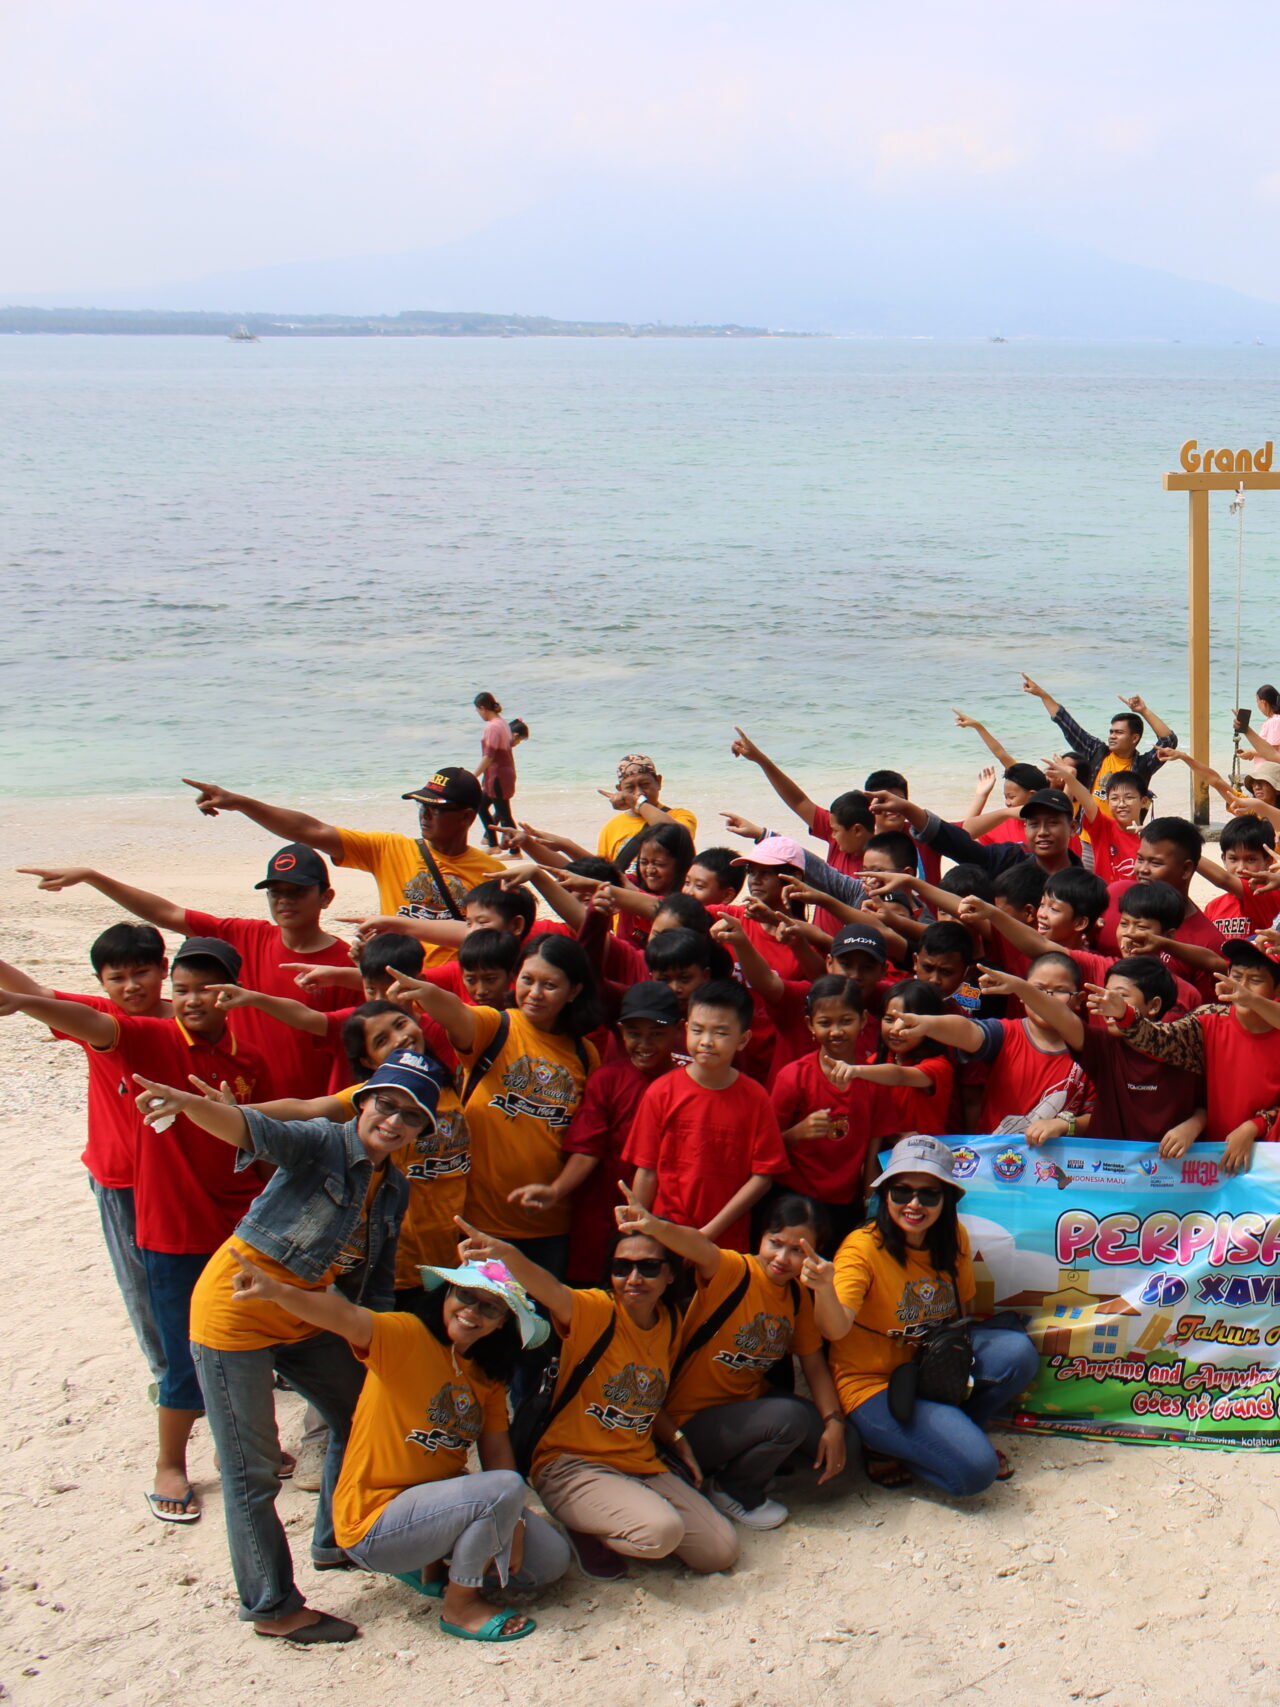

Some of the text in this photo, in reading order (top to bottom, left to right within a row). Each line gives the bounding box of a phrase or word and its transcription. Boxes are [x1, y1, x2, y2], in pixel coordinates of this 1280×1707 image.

[1180, 440, 1273, 473] Grand
[536, 1106, 557, 1117] 1964
[1140, 1271, 1189, 1308] SD
[1175, 1313, 1262, 1346] Tahun
[1147, 1361, 1183, 1386] and
[1132, 1389, 1182, 1416] Goes
[1185, 1390, 1211, 1421] to
[1211, 1386, 1274, 1420] Grand
